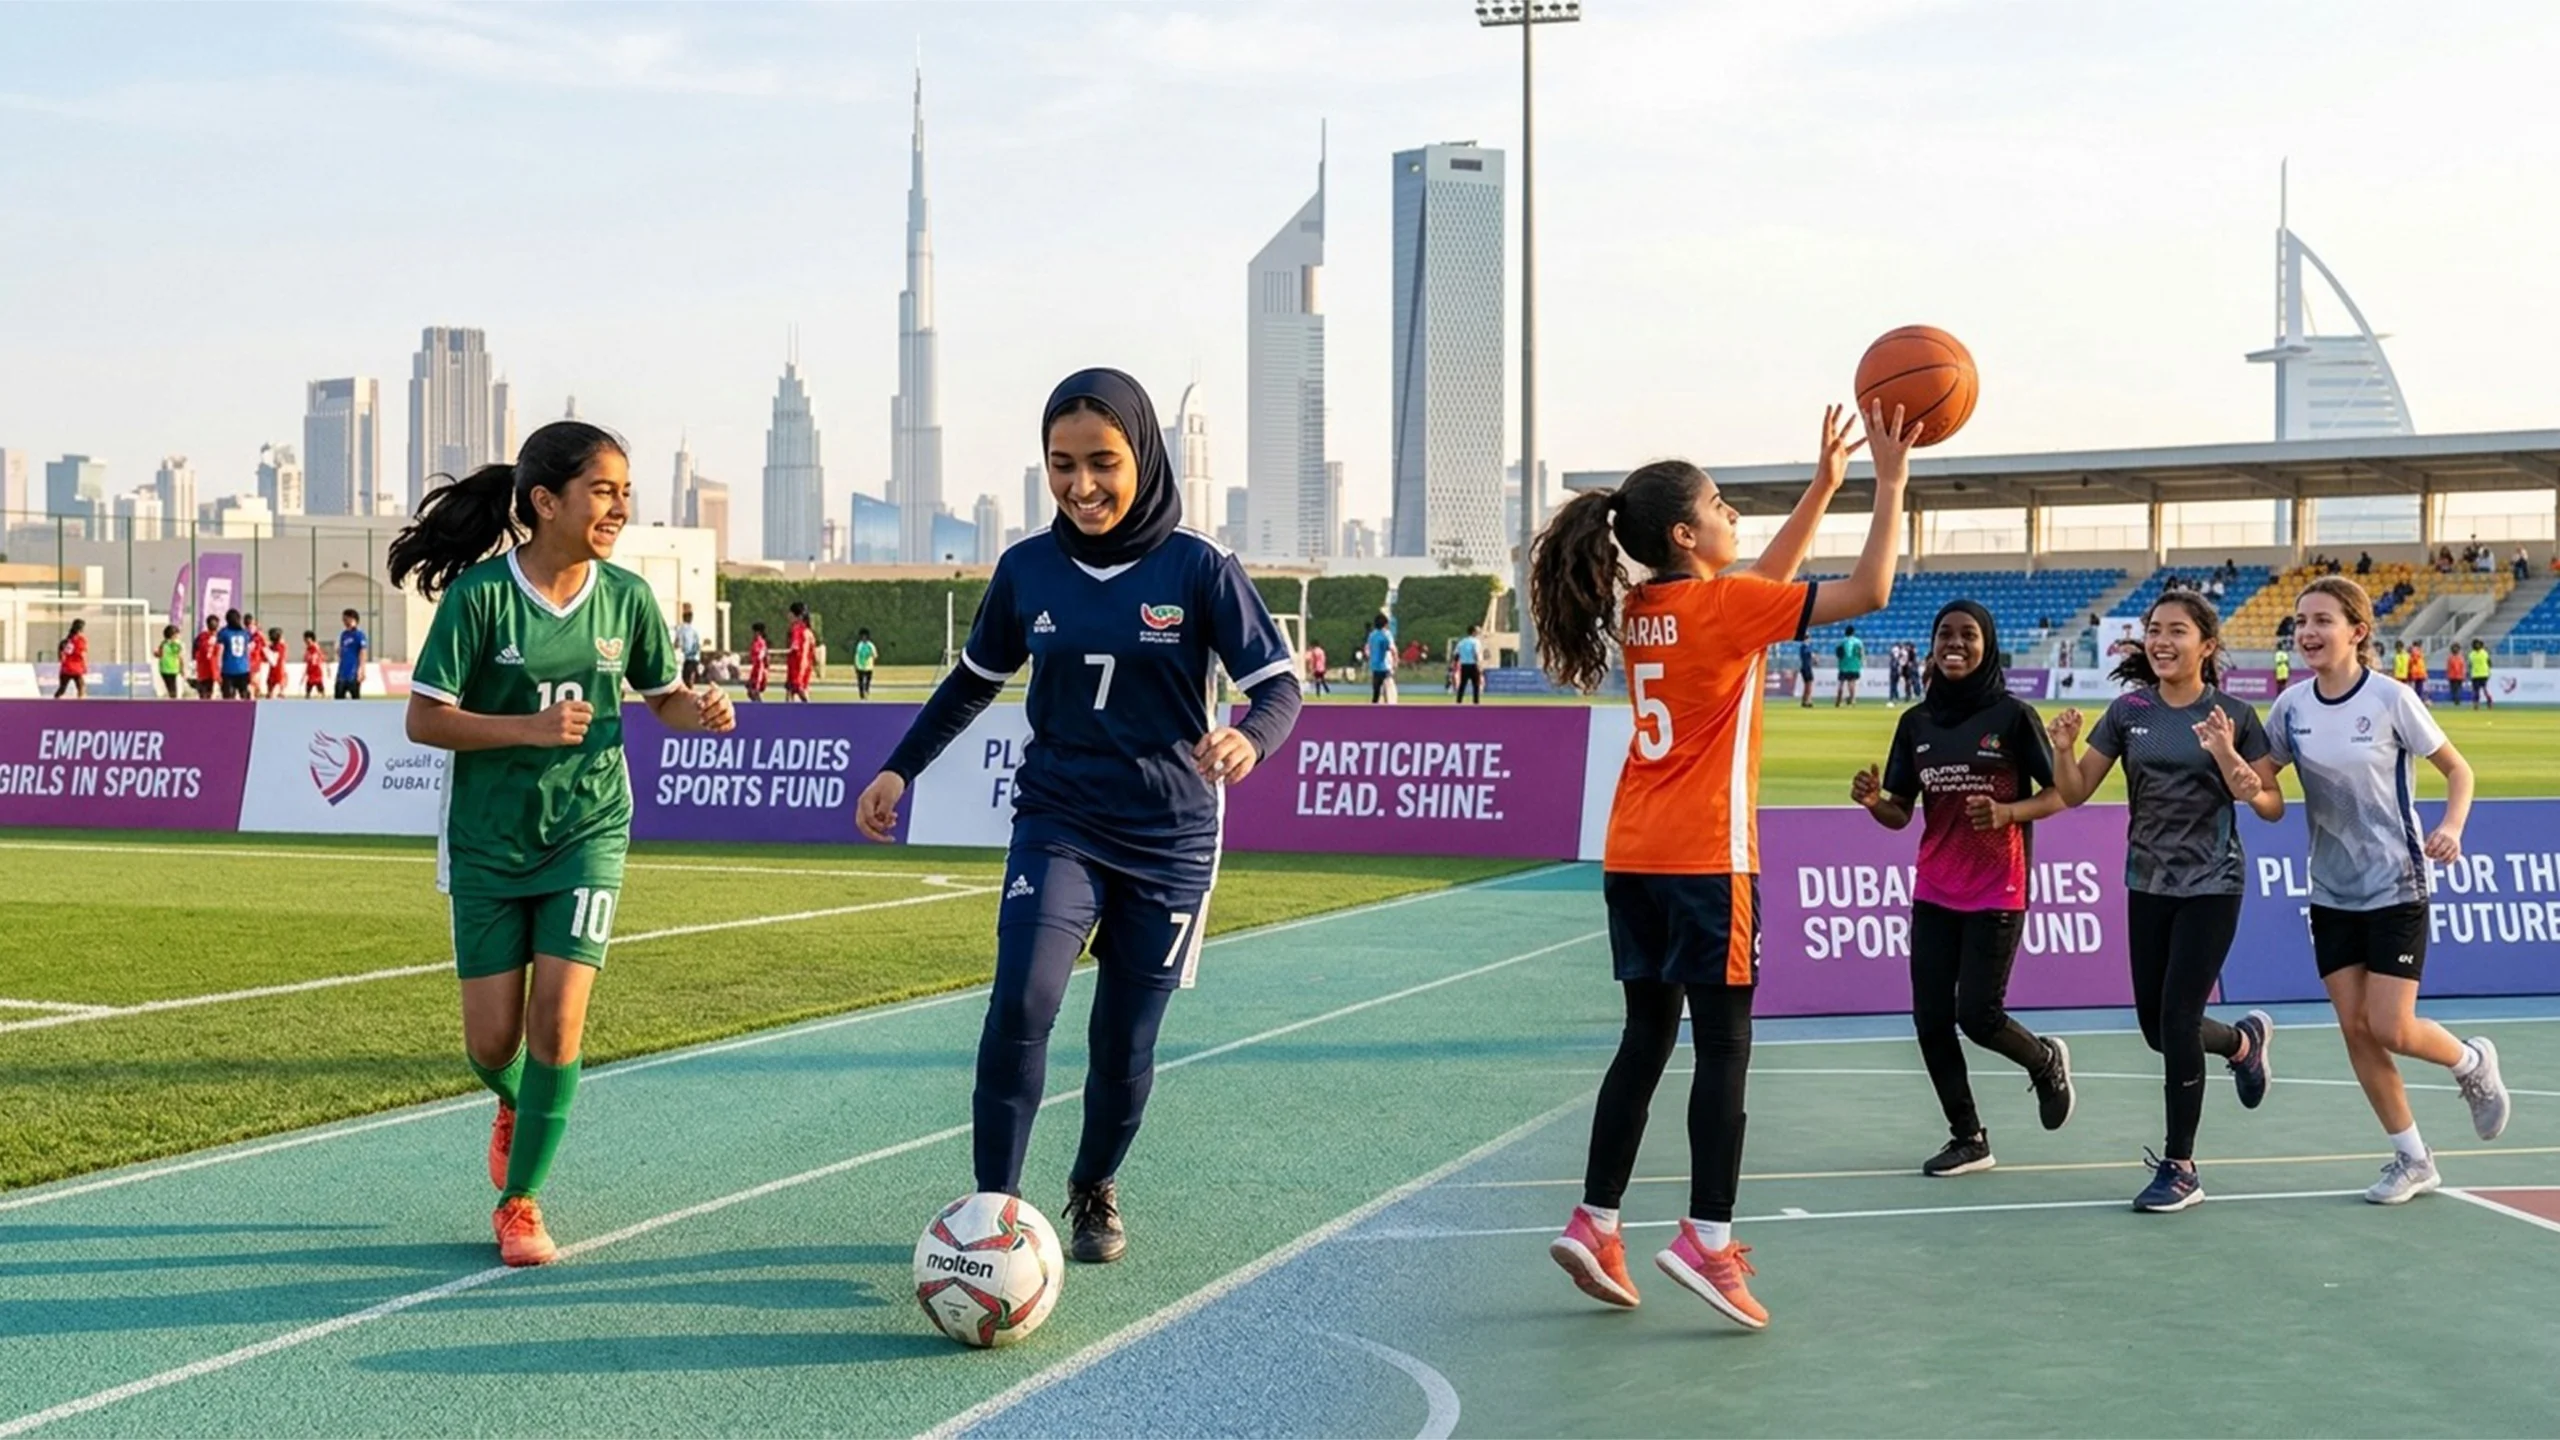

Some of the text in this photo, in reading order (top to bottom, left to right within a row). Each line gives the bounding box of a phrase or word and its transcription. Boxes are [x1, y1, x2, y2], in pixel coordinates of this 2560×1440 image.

[1626, 615, 1678, 646] ARAB
[1084, 654, 1116, 710] 7
[1634, 662, 1673, 761] 5
[38, 729, 164, 761] EMPOWER
[661, 738, 851, 771] DUBAI LADIES
[1298, 740, 1511, 778] PARTICIPATE.
[0, 763, 201, 798] GIRLS IN SPORTS
[382, 775, 431, 790] DUBAI
[656, 774, 845, 808] SPORTS FUND
[1297, 781, 1504, 820] LEAD. SHINE.
[570, 886, 613, 944] 10
[1162, 912, 1192, 967] 7
[1803, 914, 1911, 959] SPOR
[2022, 911, 2102, 955] UND
[926, 1253, 994, 1279] molten
